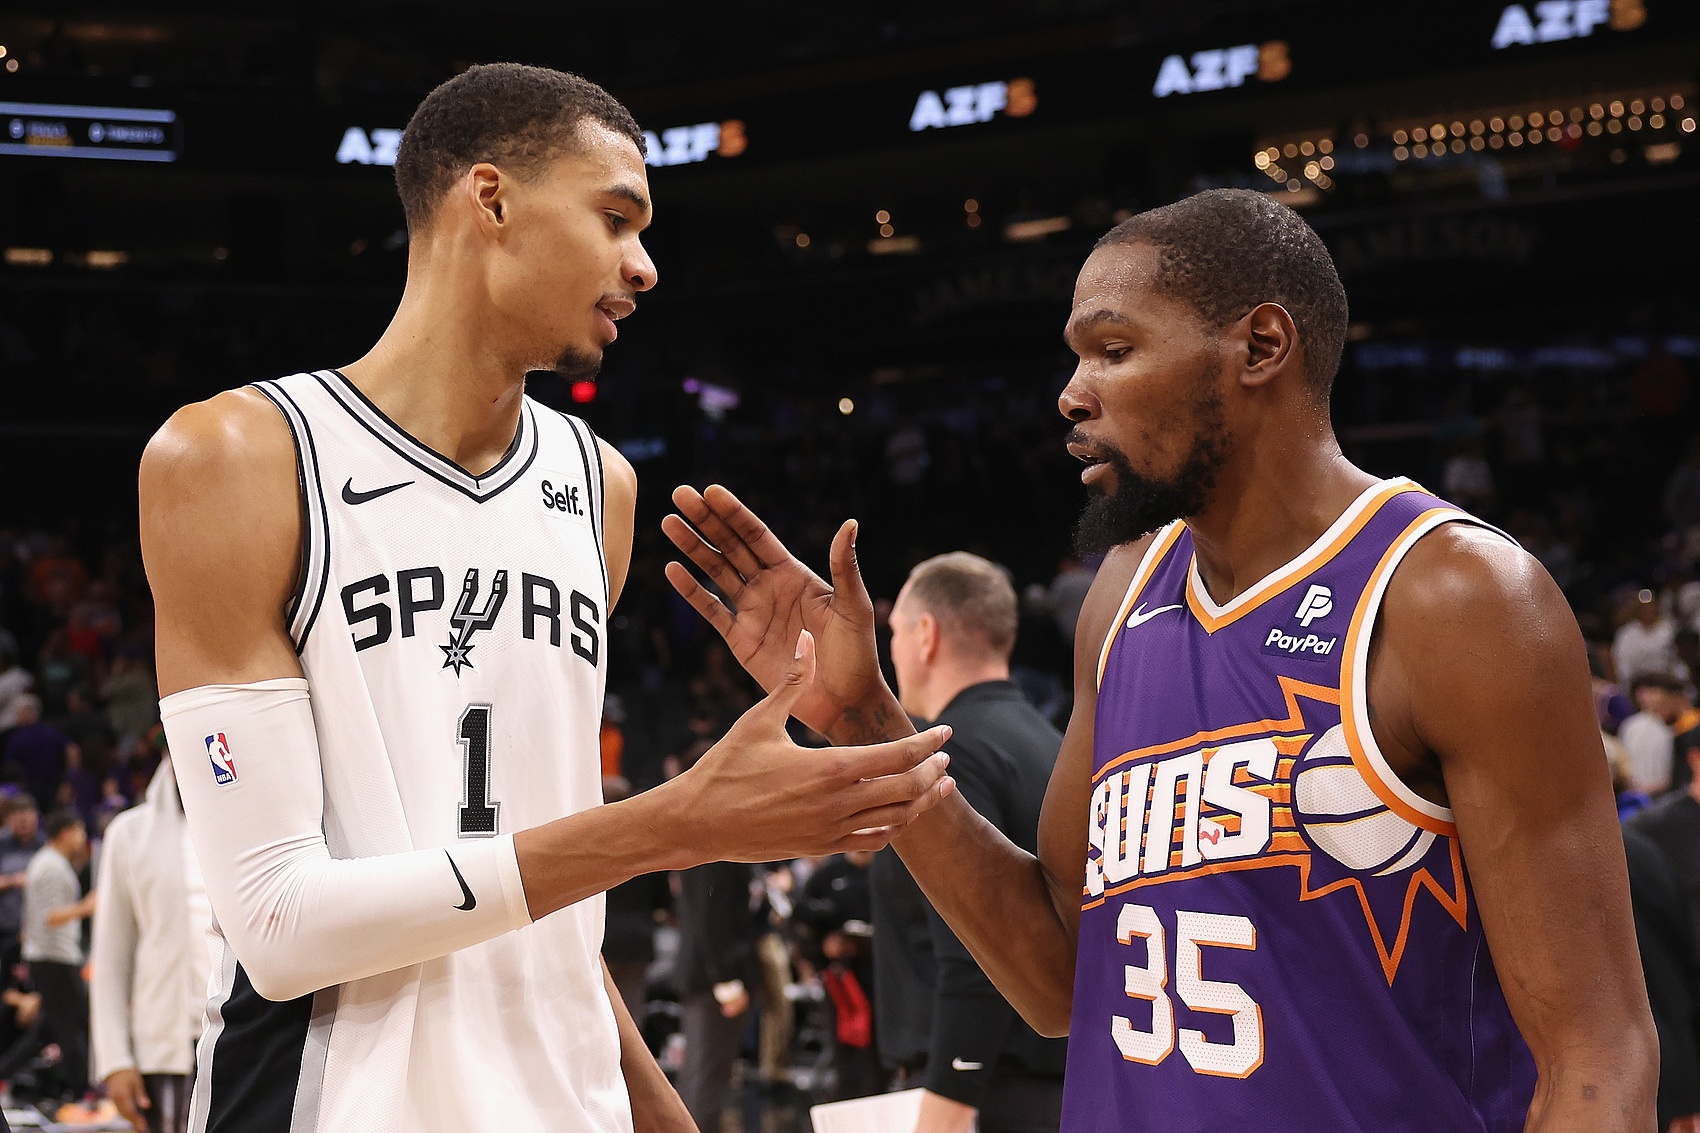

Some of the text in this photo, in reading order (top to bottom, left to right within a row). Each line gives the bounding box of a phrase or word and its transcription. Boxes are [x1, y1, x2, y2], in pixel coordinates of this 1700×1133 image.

[335, 126, 404, 166] AZ
[1337, 216, 1533, 271] AMESON
[911, 262, 1074, 326] JAMESO
[541, 480, 583, 516] Self.
[340, 566, 600, 678] SPURS
[1265, 628, 1337, 655] PayPal
[216, 772, 232, 783] NBA
[456, 703, 501, 838] 1
[1086, 737, 1278, 897] SUNS
[1111, 903, 1265, 1079] 35
